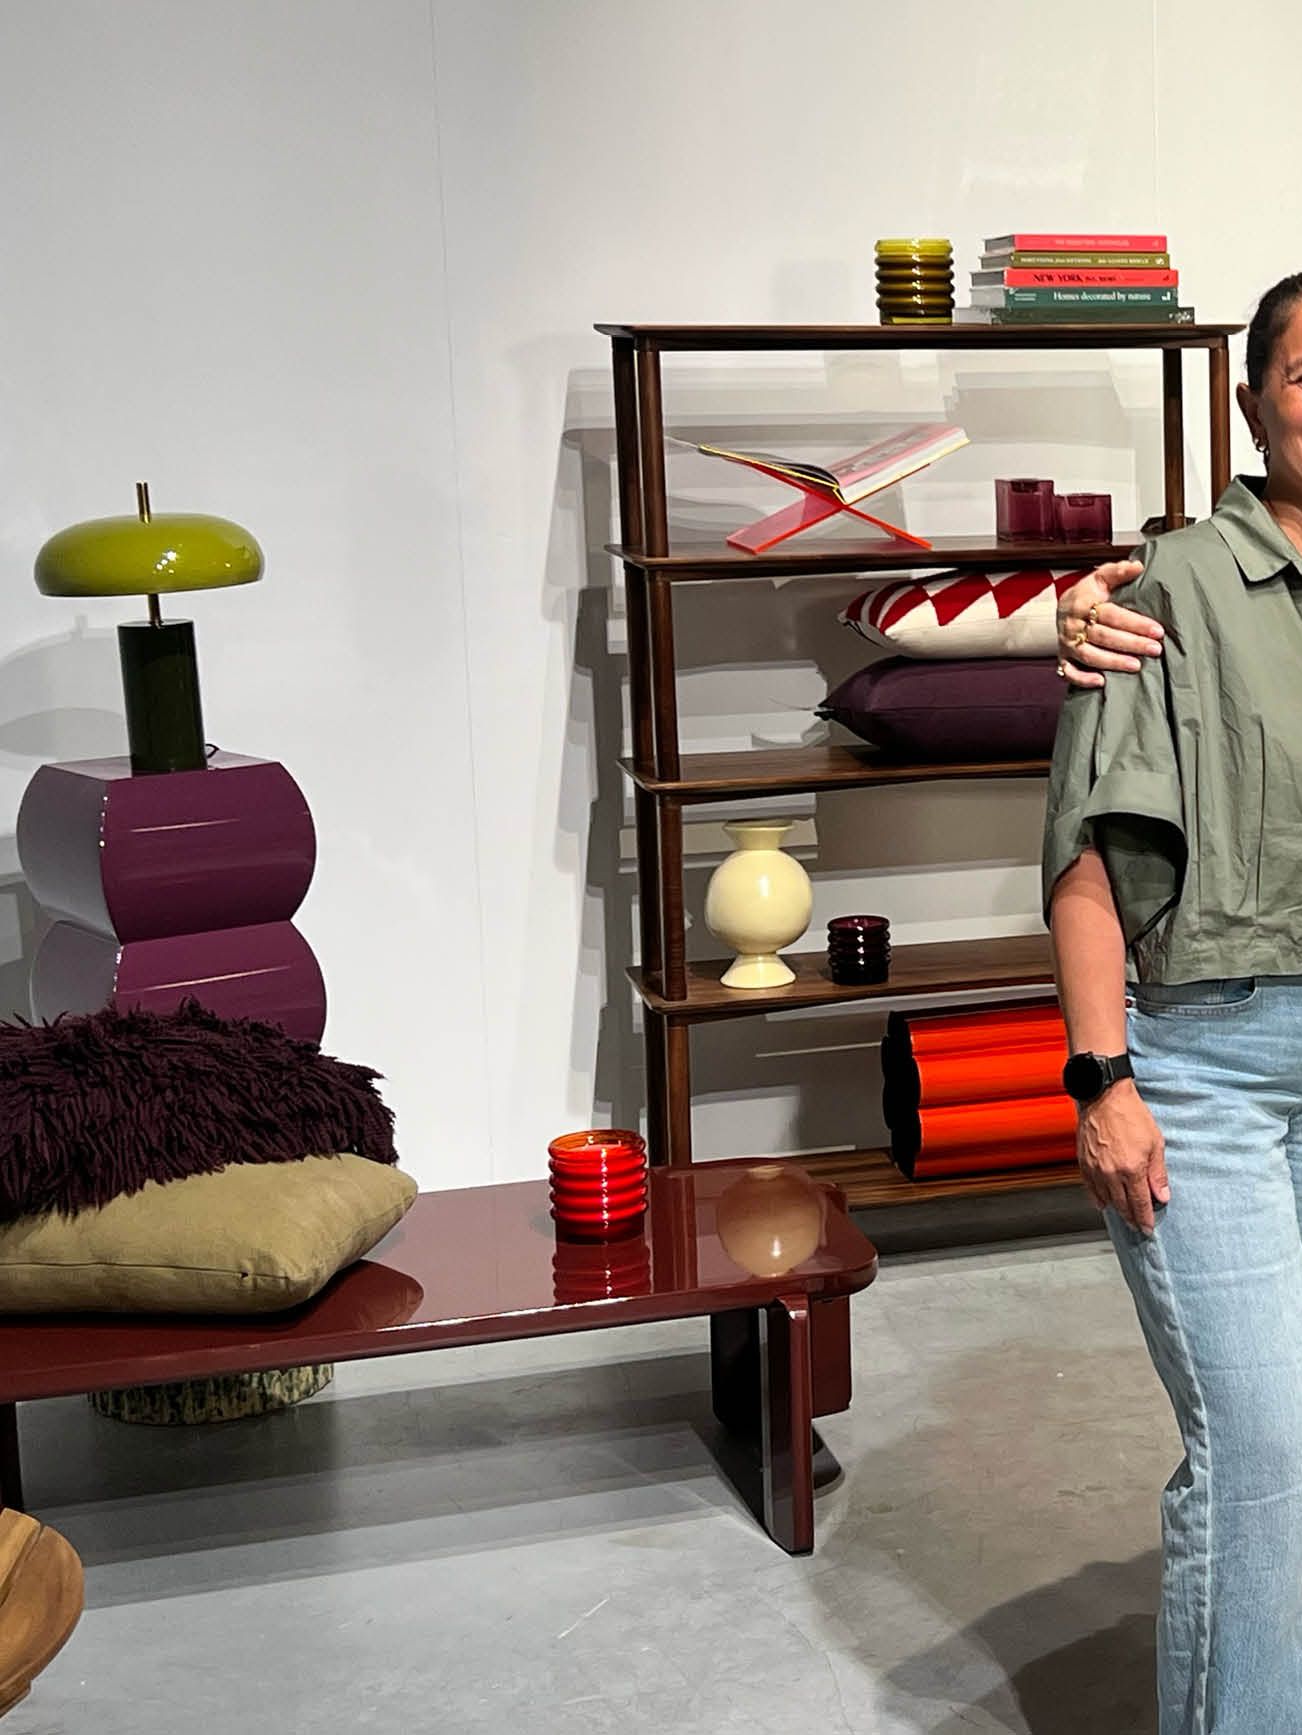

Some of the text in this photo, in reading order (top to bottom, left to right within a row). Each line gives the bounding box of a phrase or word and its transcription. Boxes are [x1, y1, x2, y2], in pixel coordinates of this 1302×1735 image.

[1033, 274, 1053, 282] NEW
[1057, 274, 1083, 282] YORK
[1053, 291, 1151, 303] Homes decorated by nature
